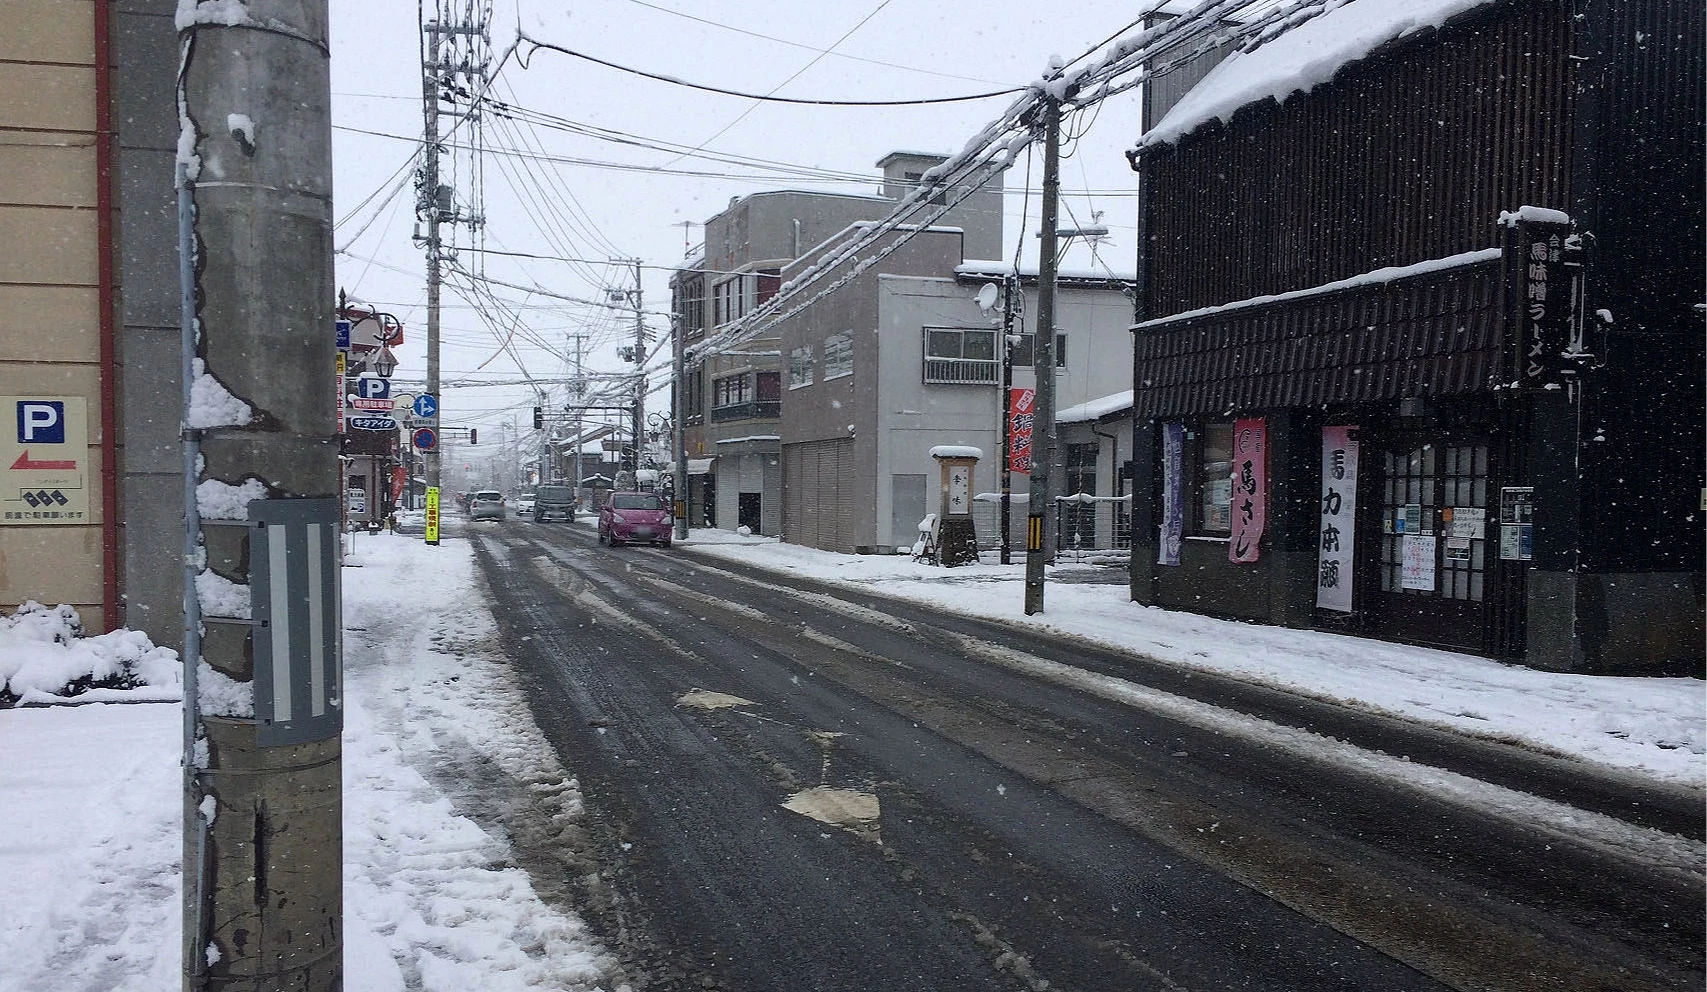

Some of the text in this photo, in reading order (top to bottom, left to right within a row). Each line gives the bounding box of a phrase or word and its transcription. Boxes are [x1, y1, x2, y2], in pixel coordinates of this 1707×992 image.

[1549, 233, 1560, 263] 会津
[1527, 241, 1547, 378] 馬味噌ラーメン
[367, 379, 384, 398] P
[24, 405, 57, 440] P
[1011, 412, 1034, 471] 鍋料理
[1235, 459, 1256, 559] 馬さし
